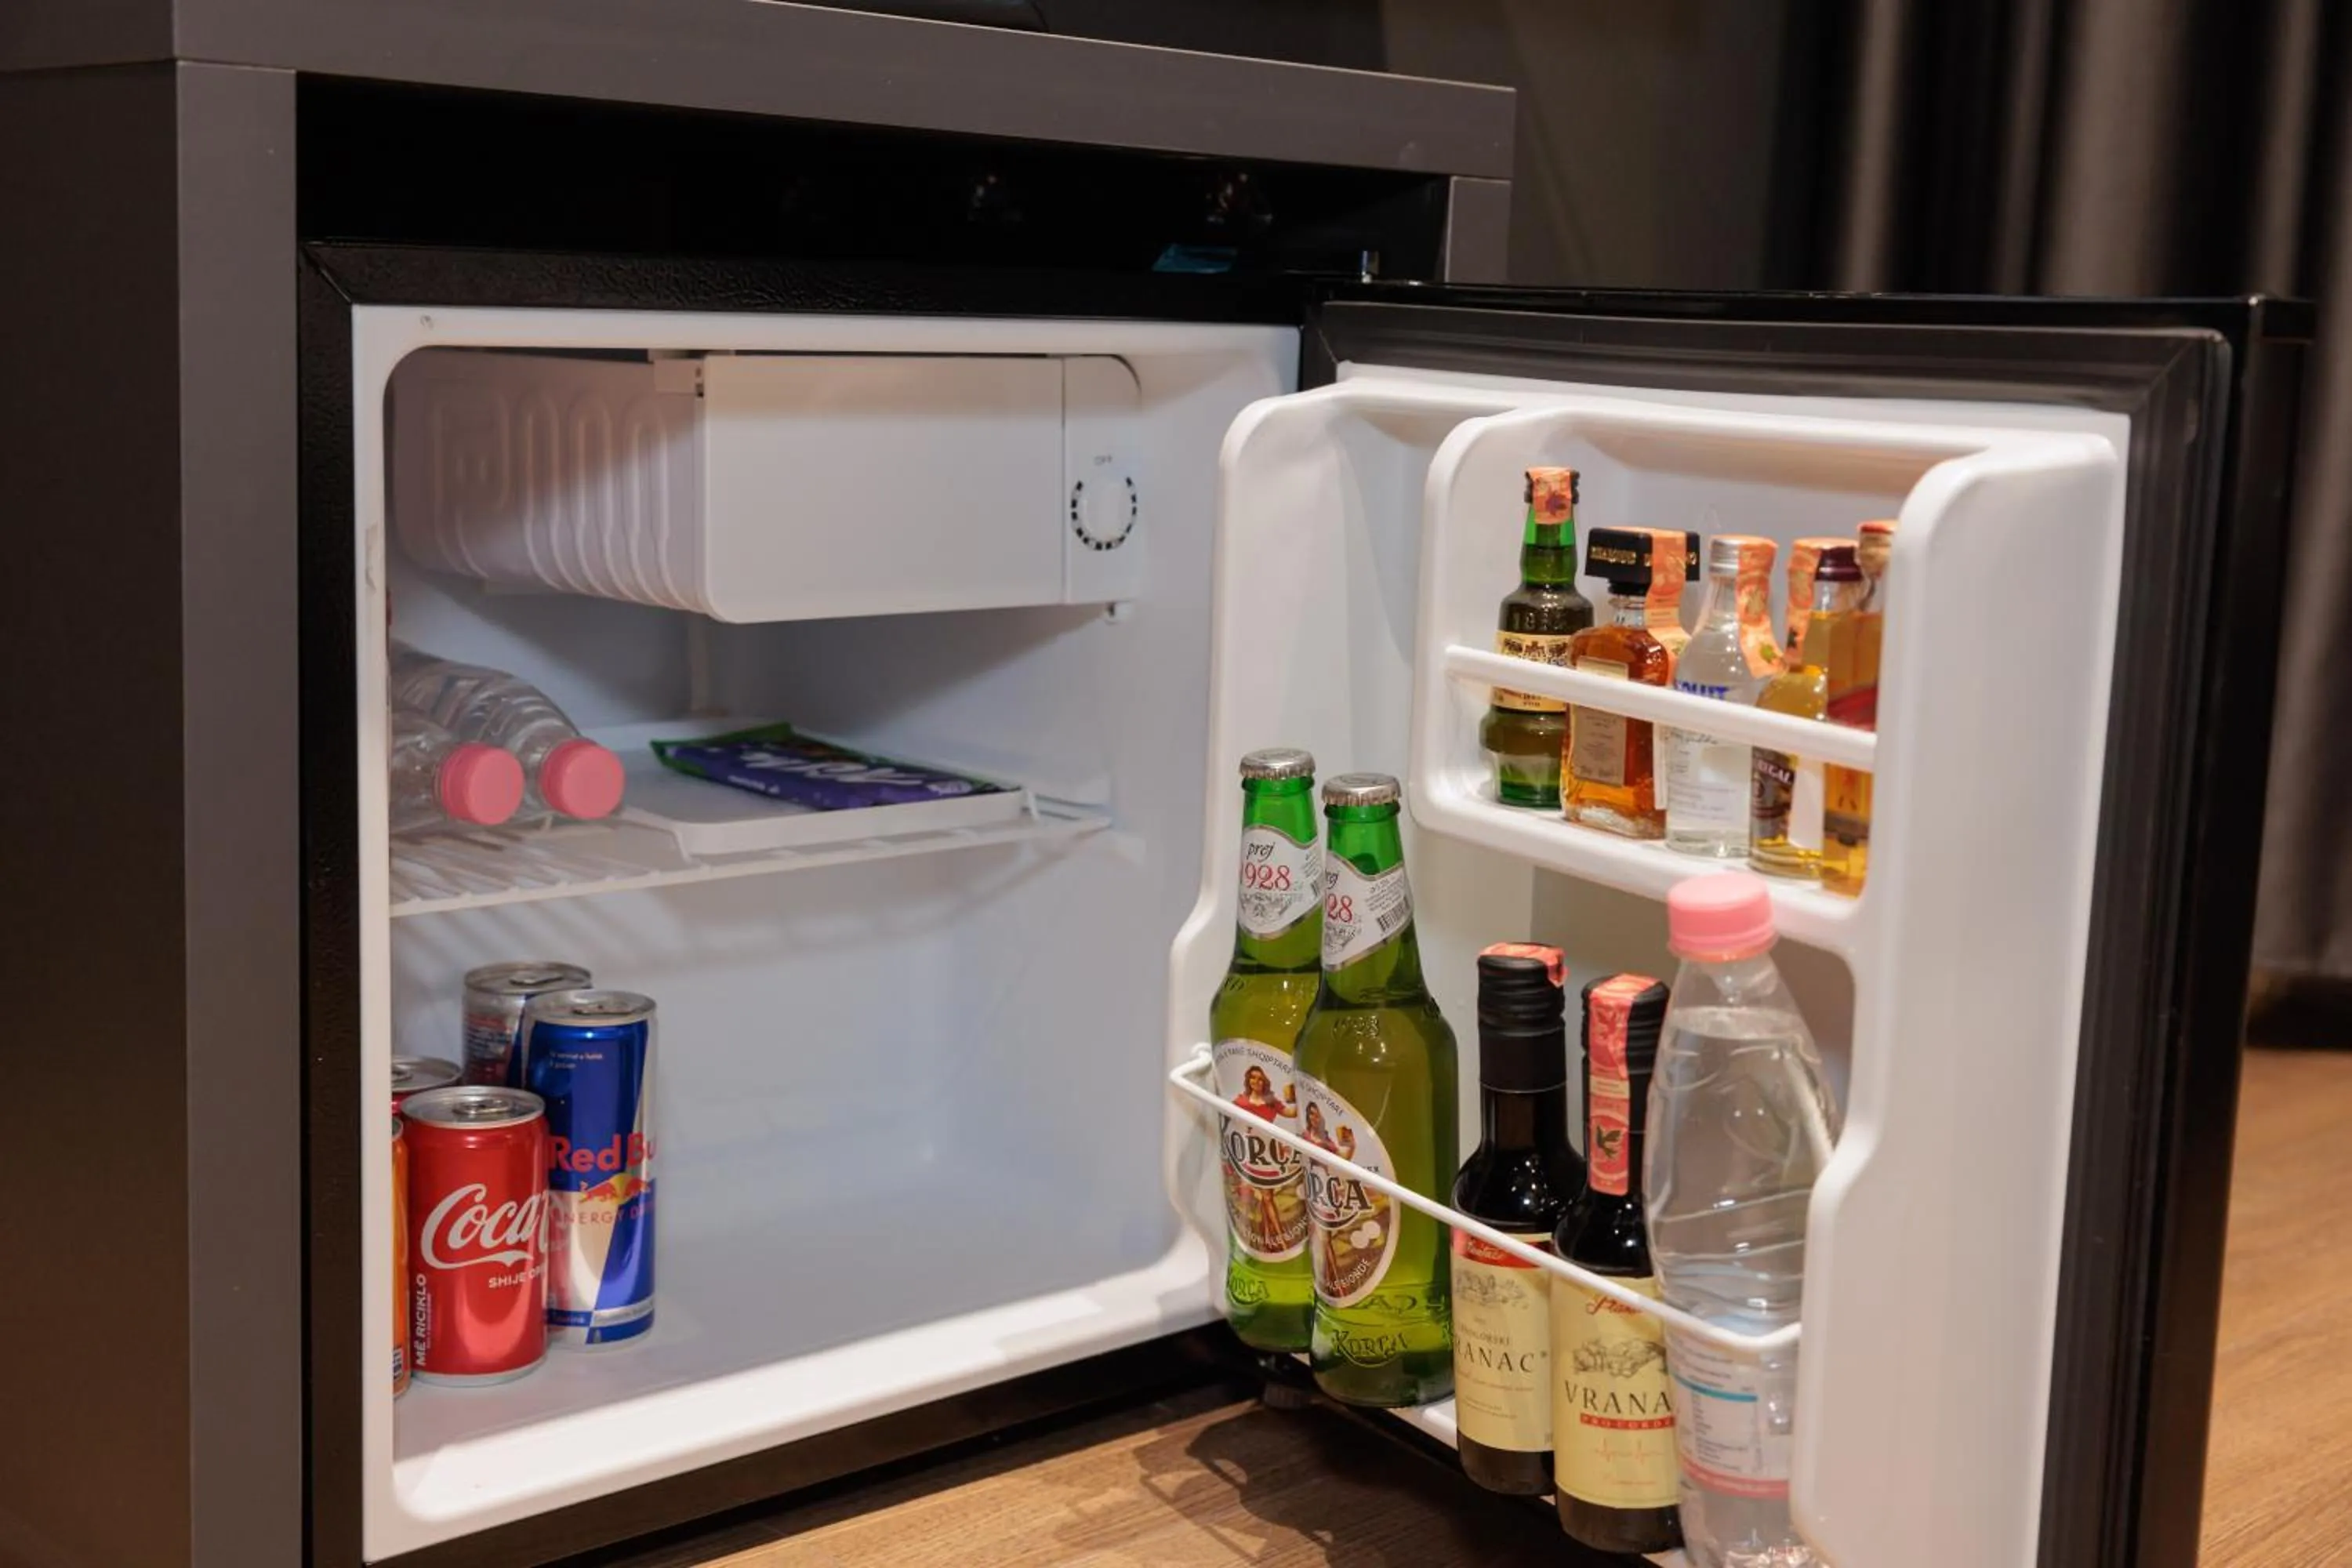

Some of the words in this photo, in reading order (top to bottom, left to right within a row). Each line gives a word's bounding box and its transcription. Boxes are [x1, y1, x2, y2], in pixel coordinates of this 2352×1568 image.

[1327, 893, 1353, 923] 28
[549, 1134, 621, 1173] Red
[627, 1131, 657, 1167] Bu
[415, 1272, 427, 1333] RICIKLO
[1454, 1337, 1537, 1374] RANAC
[1565, 1379, 1672, 1414] VRANA
